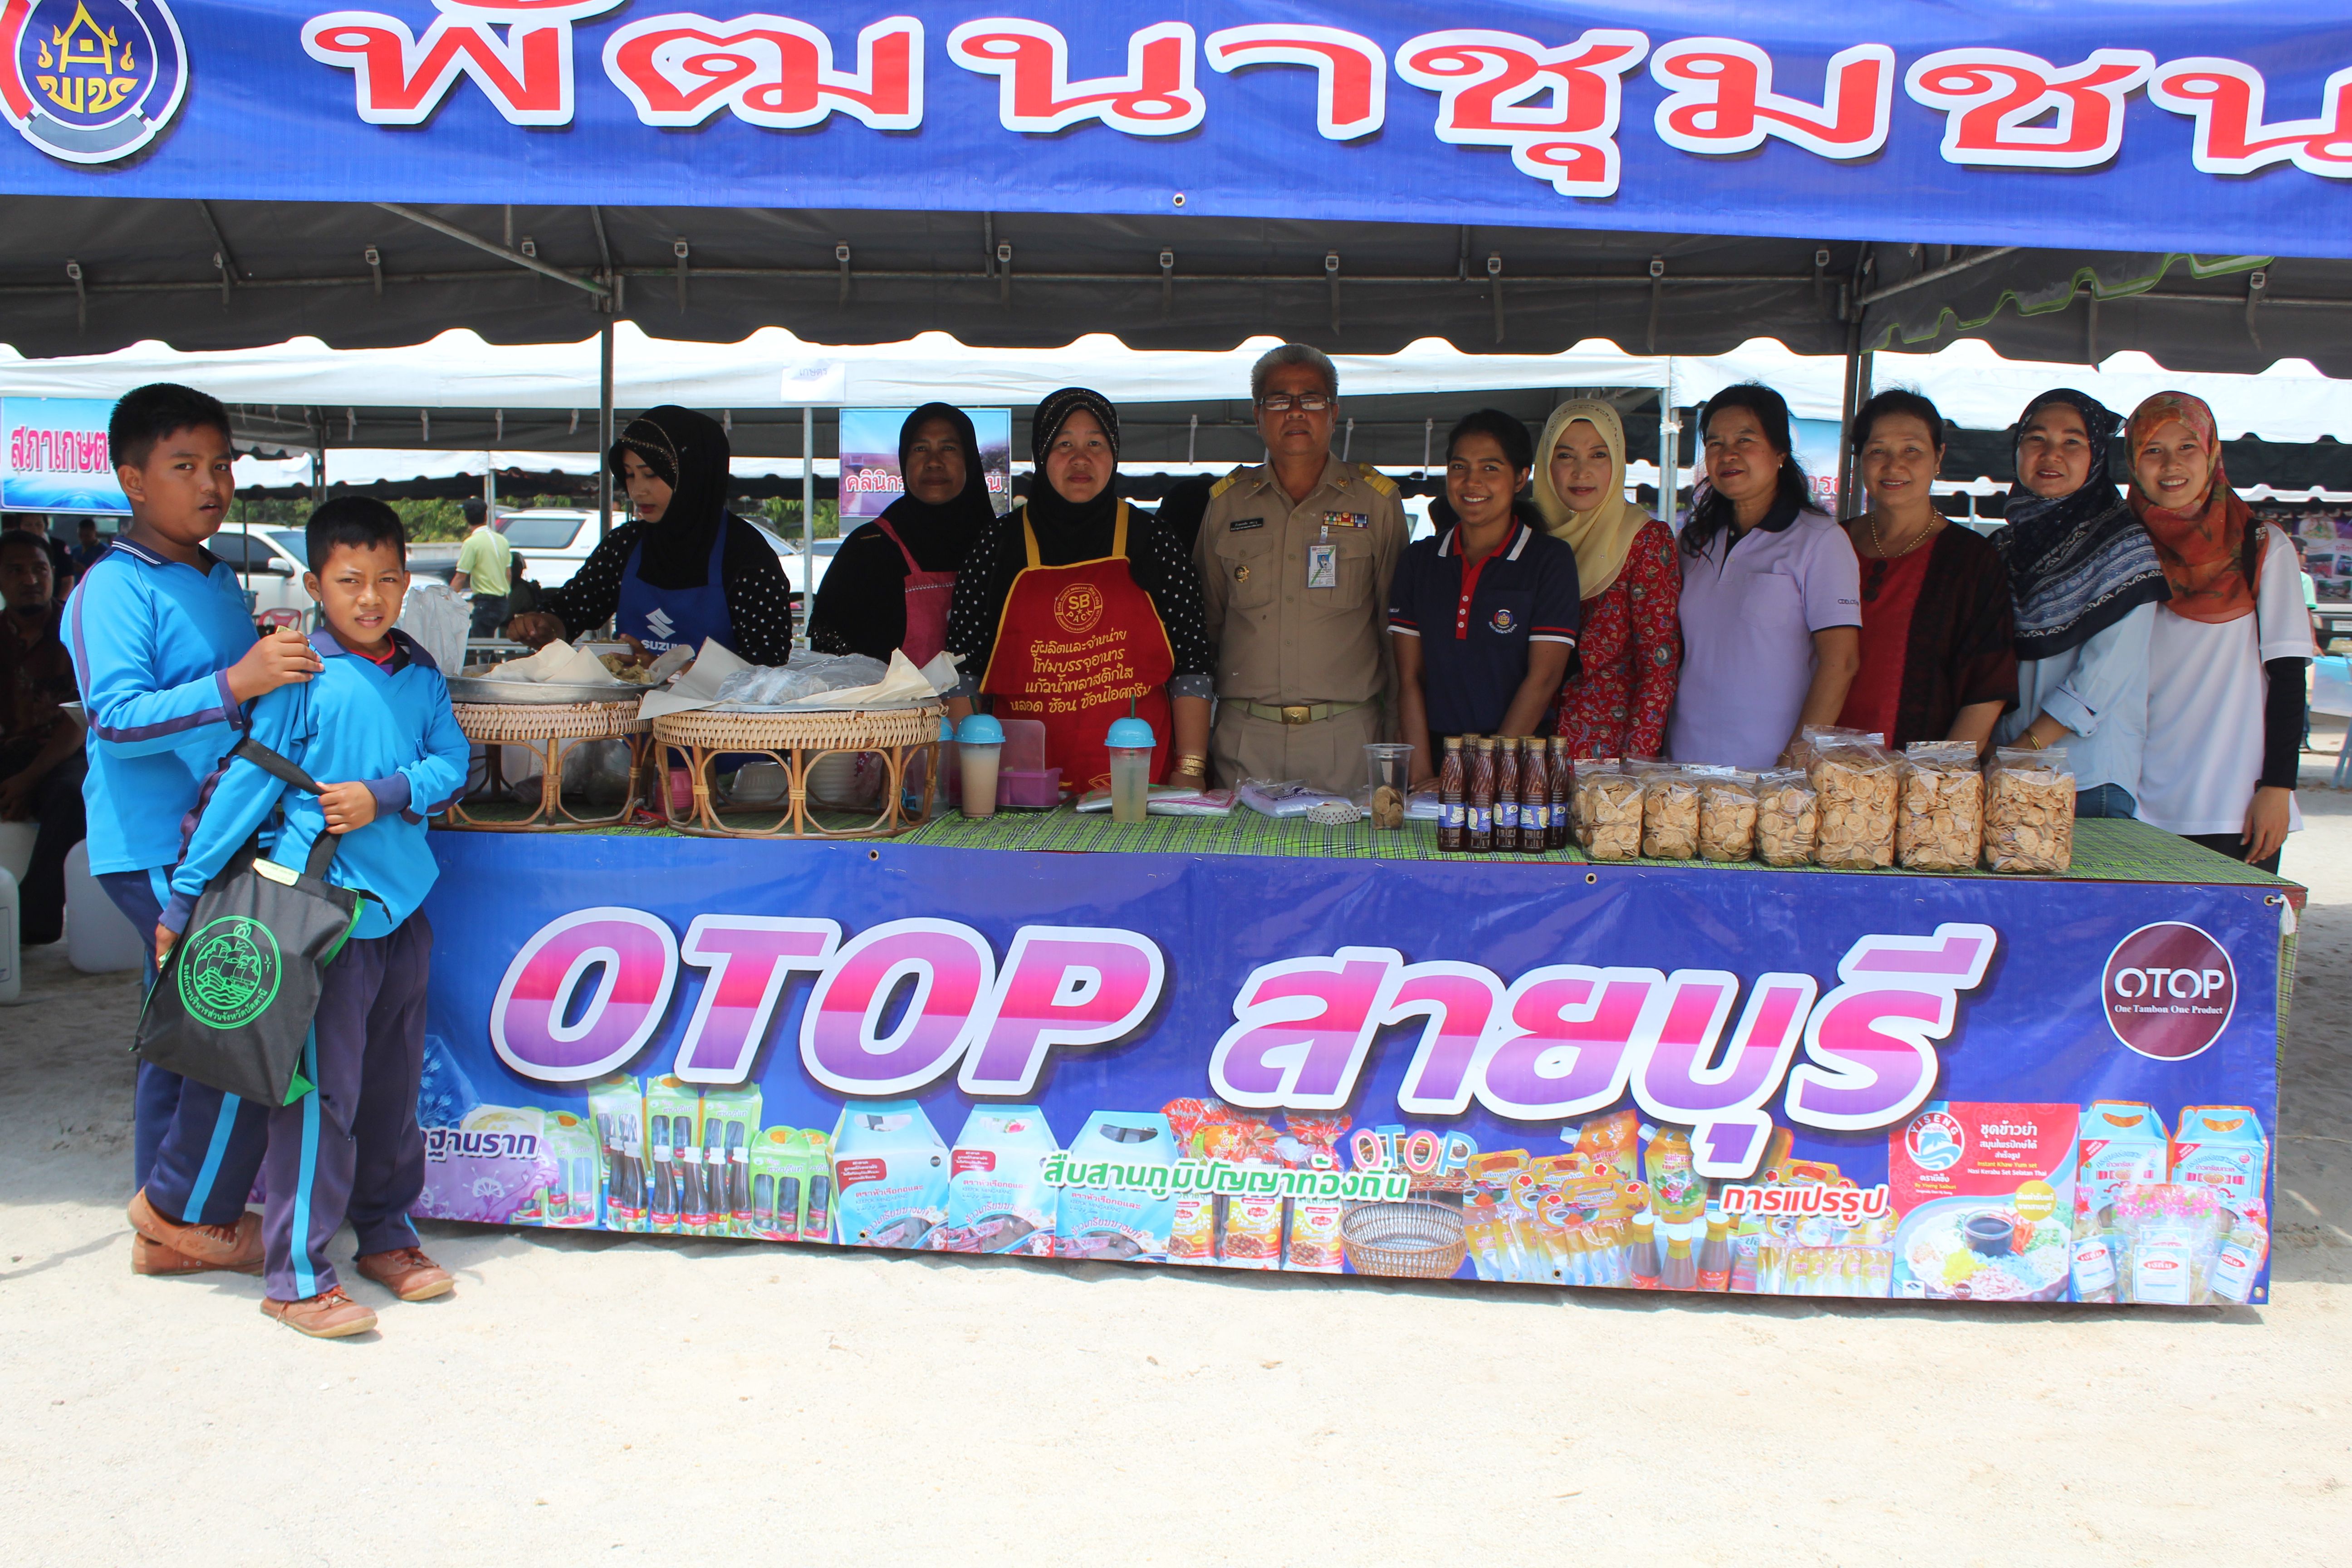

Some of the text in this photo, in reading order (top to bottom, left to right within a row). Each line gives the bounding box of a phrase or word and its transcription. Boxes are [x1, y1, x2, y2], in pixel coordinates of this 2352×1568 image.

[1065, 608, 1093, 622] PACK
[1068, 593, 1090, 610] SB
[1030, 627, 1127, 657] ผู้ผลิตและจำหน่าย
[1033, 648, 1126, 673] โฟมบรรจุอาหาร
[1025, 662, 1134, 693] แก้วน้ำพลาสติกใส
[1010, 700, 1044, 712] หลอด
[1048, 697, 1077, 713] ช้อน
[183, 964, 269, 1021] องค์การบริหารส่วนจังหวัดปัตตานี
[2114, 967, 2225, 999] OTOP
[490, 907, 1165, 1096] OTOP
[2114, 1004, 2223, 1015] One Tambon One Product
[1209, 922, 1997, 1179] สายบุรี
[1911, 1114, 1959, 1136] YISENG
[1980, 1120, 2038, 1139] ชุดข้าวยำ
[1350, 1124, 1479, 1177] OTOP
[1041, 1150, 1411, 1203] สืบสานภูมิปัญญาท้องถิ่น
[1719, 1183, 1889, 1227] การแปรรูป
